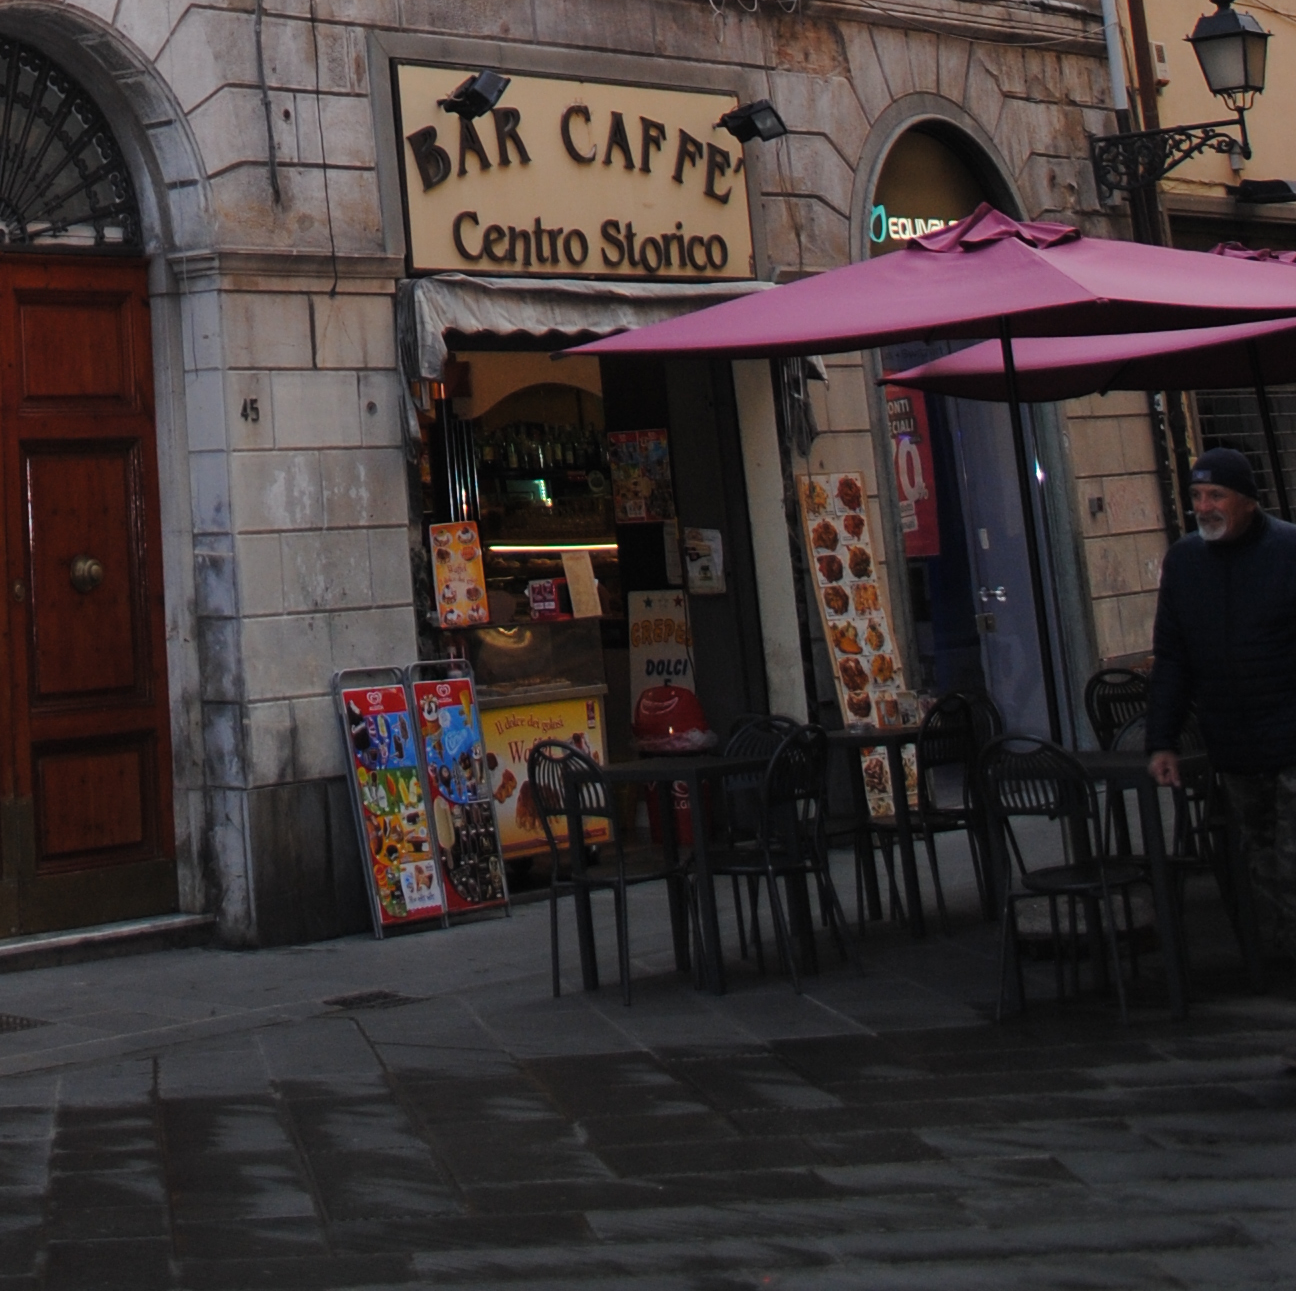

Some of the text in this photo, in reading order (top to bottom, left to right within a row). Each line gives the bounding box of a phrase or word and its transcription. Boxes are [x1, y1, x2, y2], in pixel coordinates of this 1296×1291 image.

[406, 104, 746, 204] BAR CAFFE'
[452, 210, 728, 273] Centro Storico
[240, 398, 260, 423] 45
[887, 398, 910, 415] ONTI
[645, 658, 689, 676] DOLCI
[505, 713, 525, 731] dolce
[527, 714, 540, 729] dei
[542, 715, 564, 733] golosi
